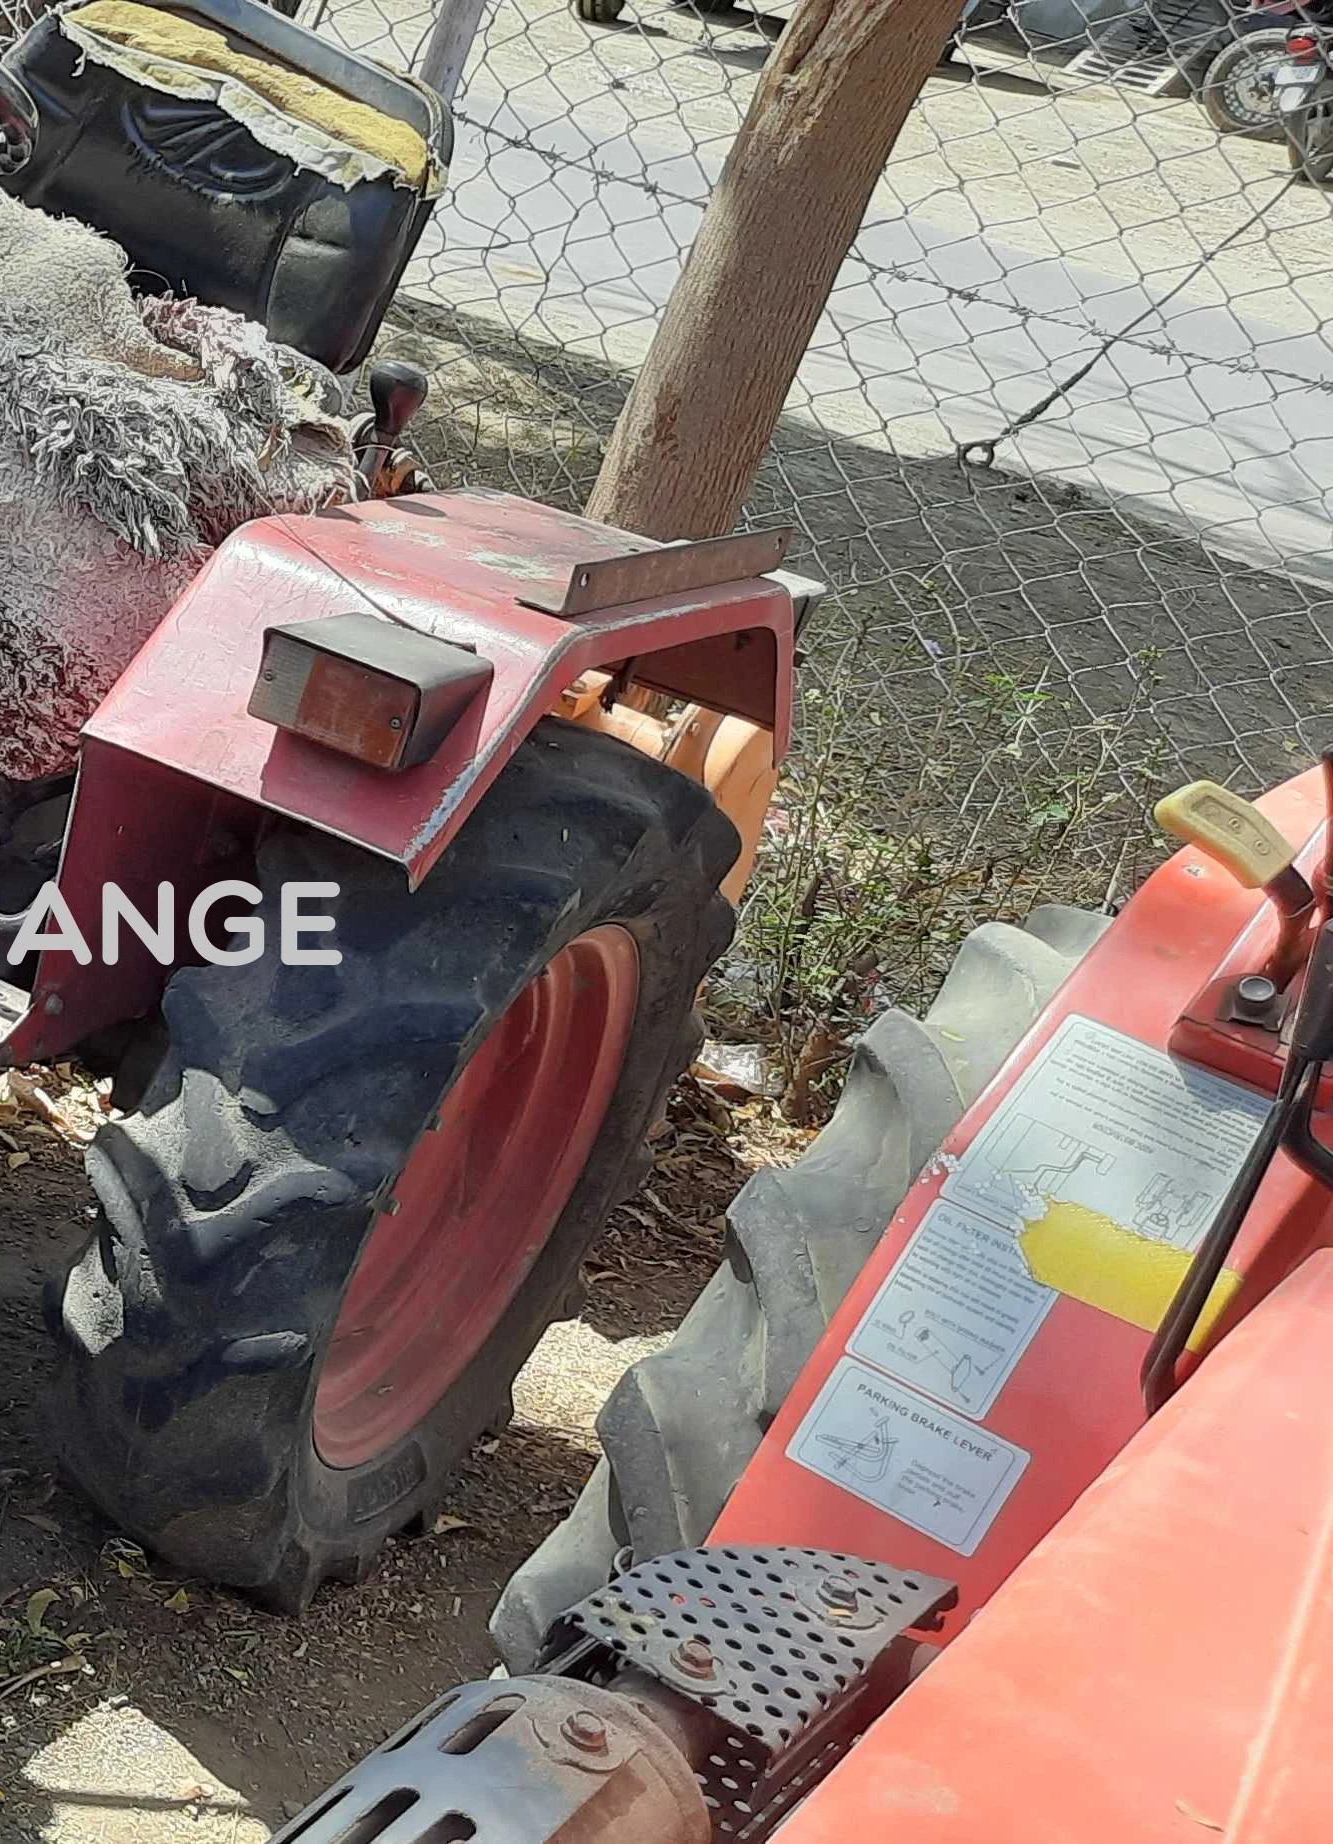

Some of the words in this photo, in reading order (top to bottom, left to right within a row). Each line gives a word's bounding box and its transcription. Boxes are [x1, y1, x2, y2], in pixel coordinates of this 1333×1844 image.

[955, 1221, 990, 1242] FILTER
[856, 1383, 908, 1417] PARKING
[910, 1411, 951, 1441] BRAKE
[952, 1435, 993, 1462] LEVER
